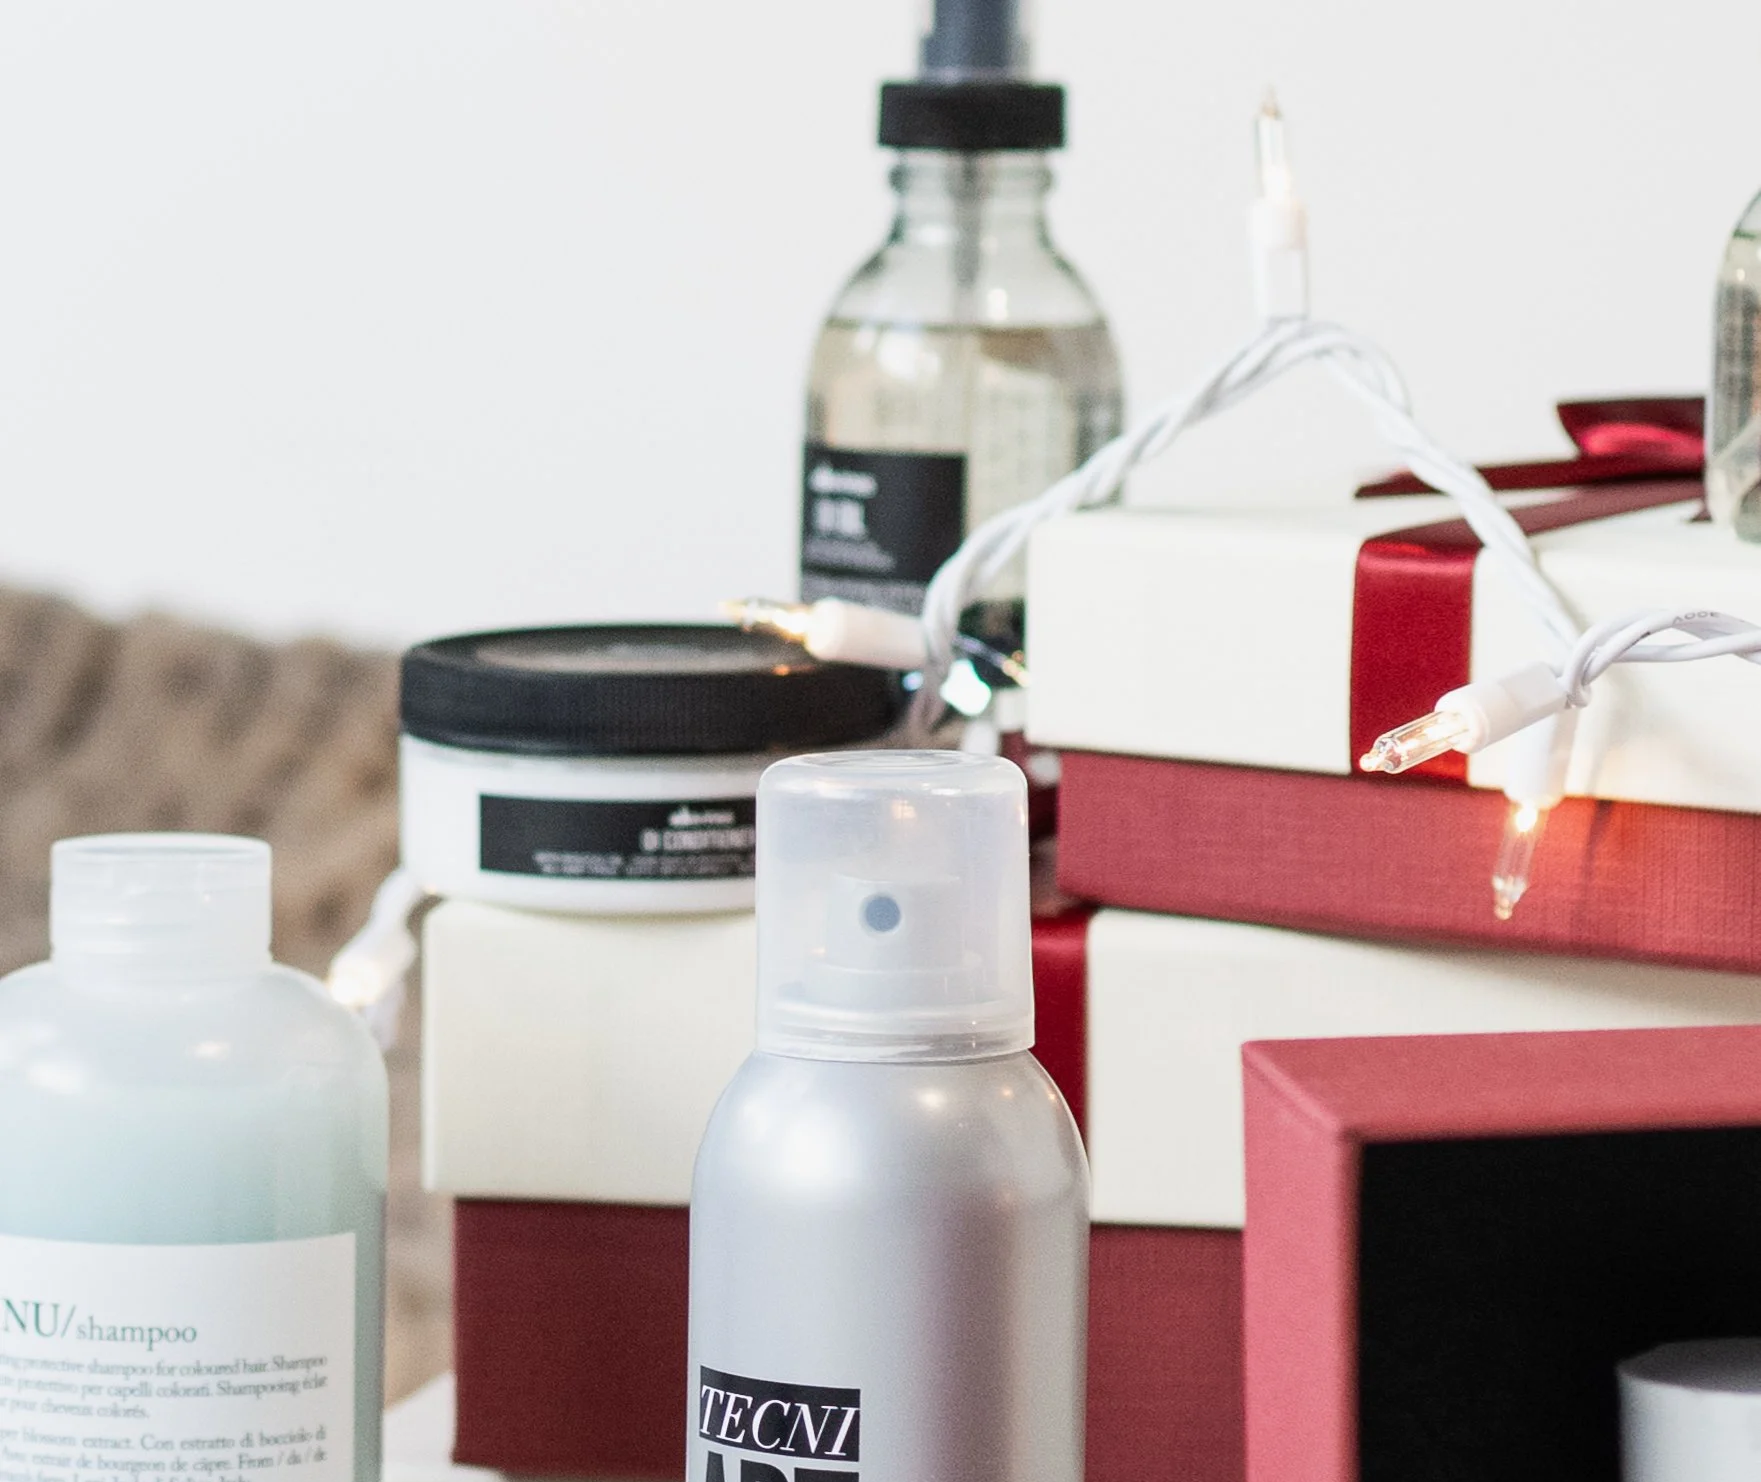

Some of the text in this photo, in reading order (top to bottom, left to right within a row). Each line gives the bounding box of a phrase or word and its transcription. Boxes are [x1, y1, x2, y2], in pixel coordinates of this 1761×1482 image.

[87, 1358, 153, 1380] shampoo
[155, 1359, 176, 1376] for
[179, 1359, 240, 1376] coloured
[272, 1354, 328, 1374] Shampoo
[81, 1384, 103, 1401] per
[107, 1381, 151, 1402] capelli
[700, 1385, 860, 1456] TECNI
[140, 1433, 174, 1451] Con
[239, 1432, 254, 1448] di
[315, 1424, 327, 1441] di
[76, 1452, 93, 1469] de
[97, 1454, 165, 1477] bourgeon
[171, 1456, 188, 1472] de
[237, 1452, 274, 1470] From
